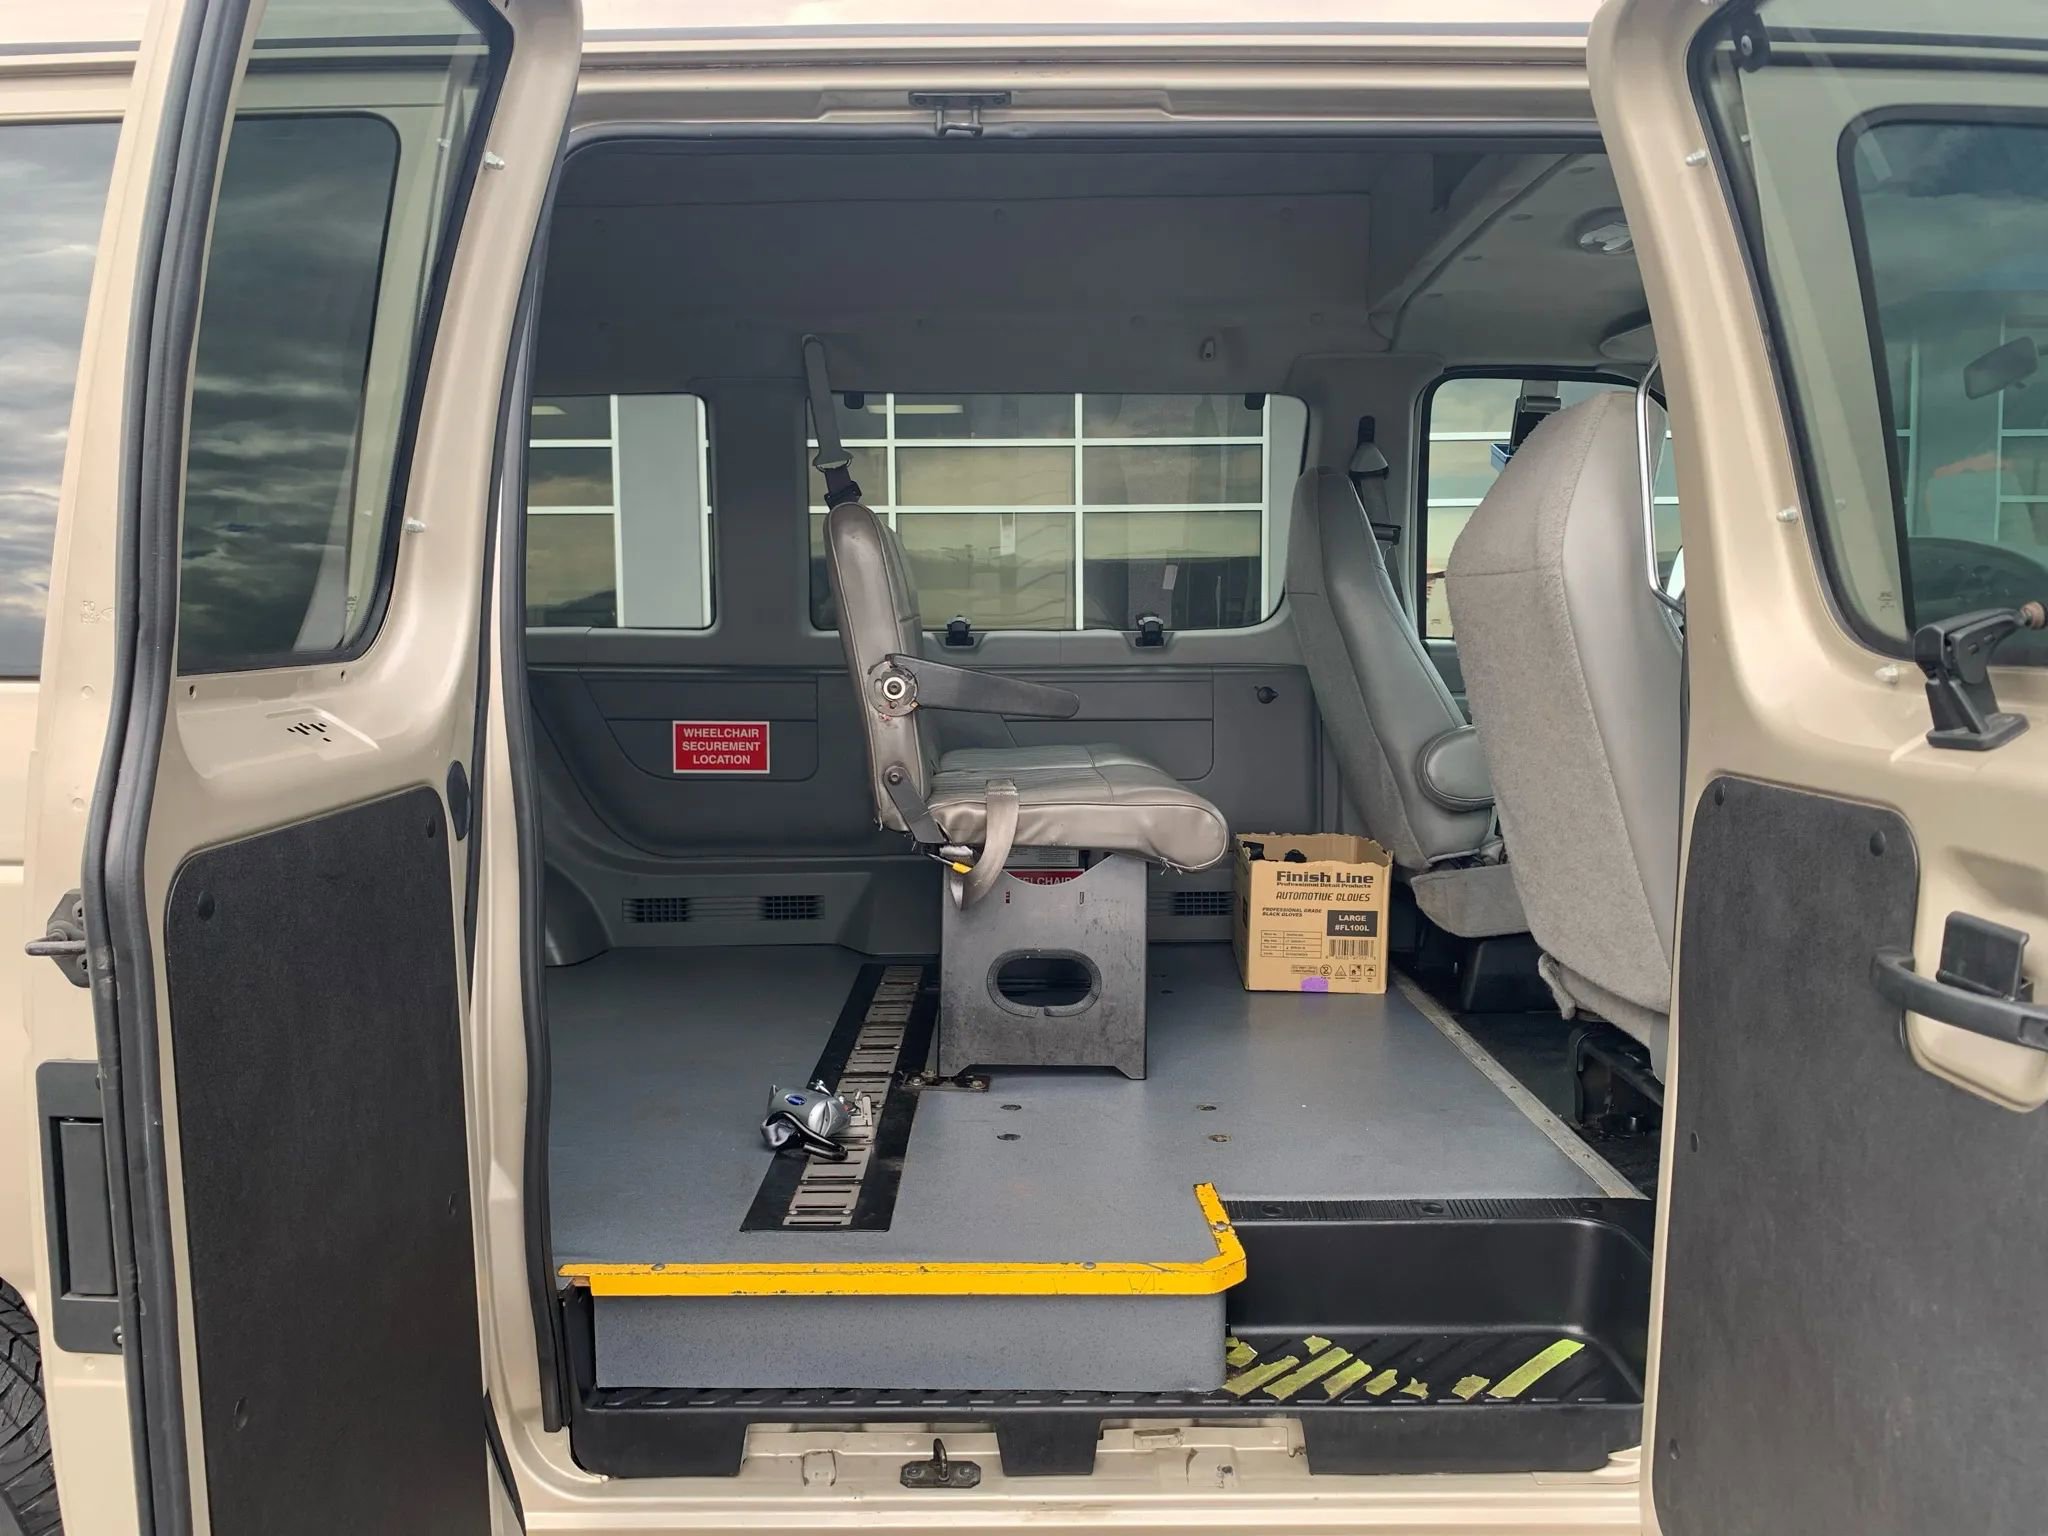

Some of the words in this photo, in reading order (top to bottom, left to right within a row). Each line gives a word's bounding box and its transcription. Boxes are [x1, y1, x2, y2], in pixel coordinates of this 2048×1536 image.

[683, 728, 759, 738] WHEELCHAIR
[682, 741, 761, 751] SECUREMENT
[693, 755, 750, 764] LOCATION
[1276, 870, 1331, 883] Finish
[1336, 872, 1374, 884] Line
[1276, 891, 1334, 901] AUTOMOTIVE
[1336, 893, 1371, 902] GLOVES
[1334, 924, 1370, 932] #FL100L
